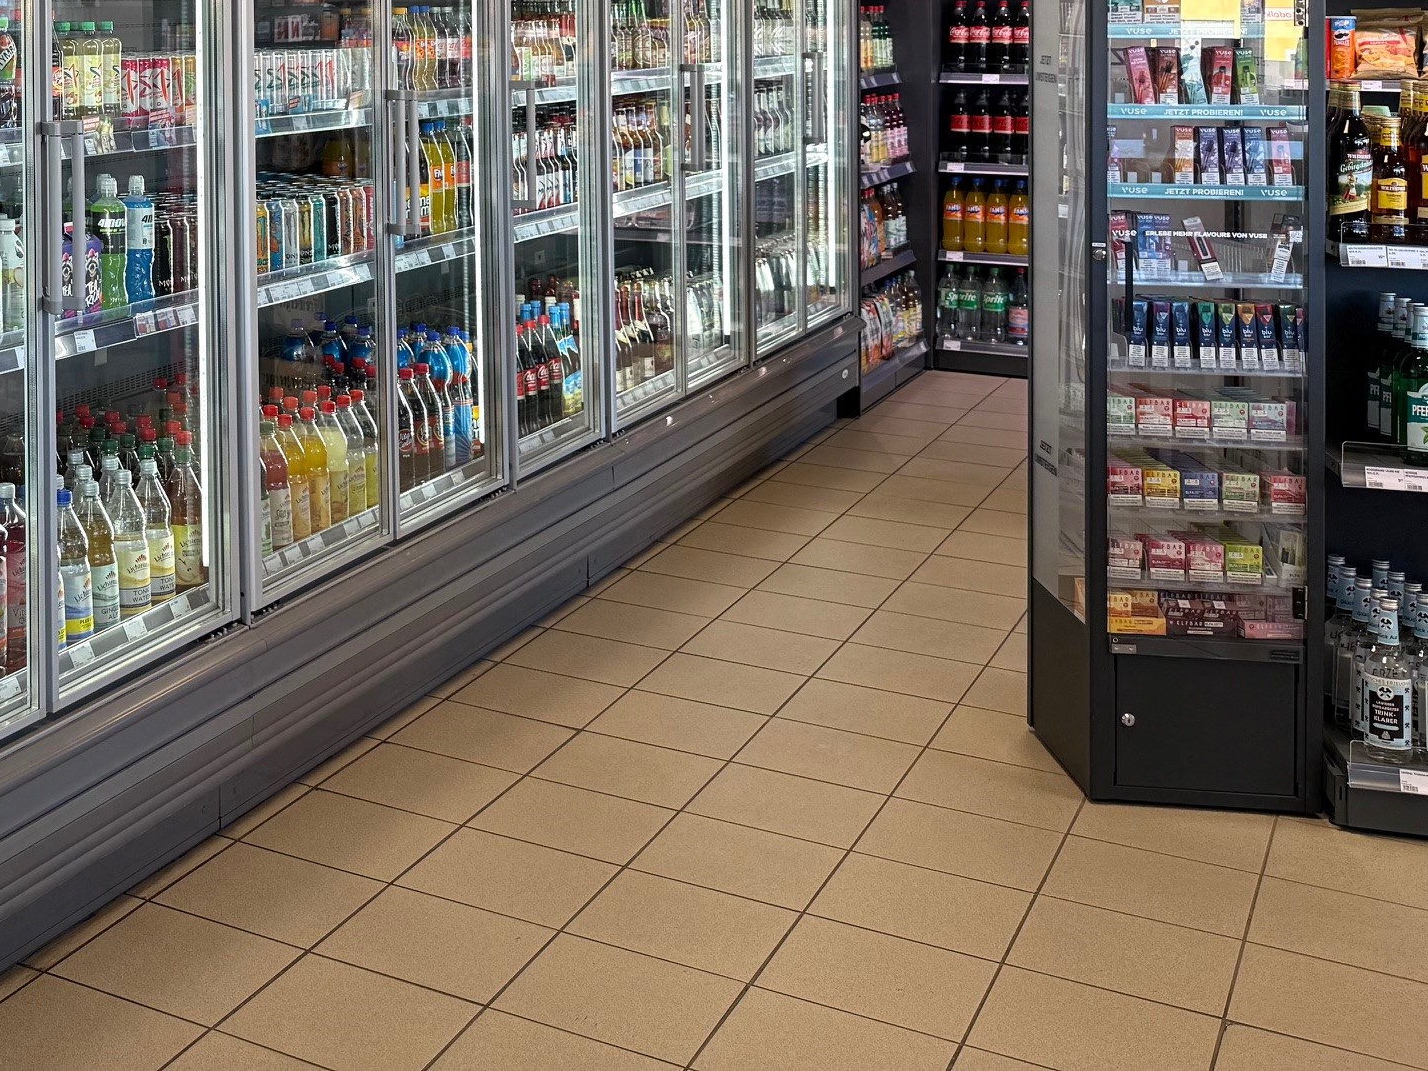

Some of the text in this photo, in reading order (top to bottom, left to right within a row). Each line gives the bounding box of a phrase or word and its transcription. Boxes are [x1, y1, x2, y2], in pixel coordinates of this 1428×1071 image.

[1164, 108, 1190, 116] JETZT
[1192, 108, 1243, 116] PROBIEREN!
[1192, 188, 1244, 196] PROBIEREN!
[983, 295, 1004, 303] Sprite
[1374, 716, 1397, 725] KLARER
